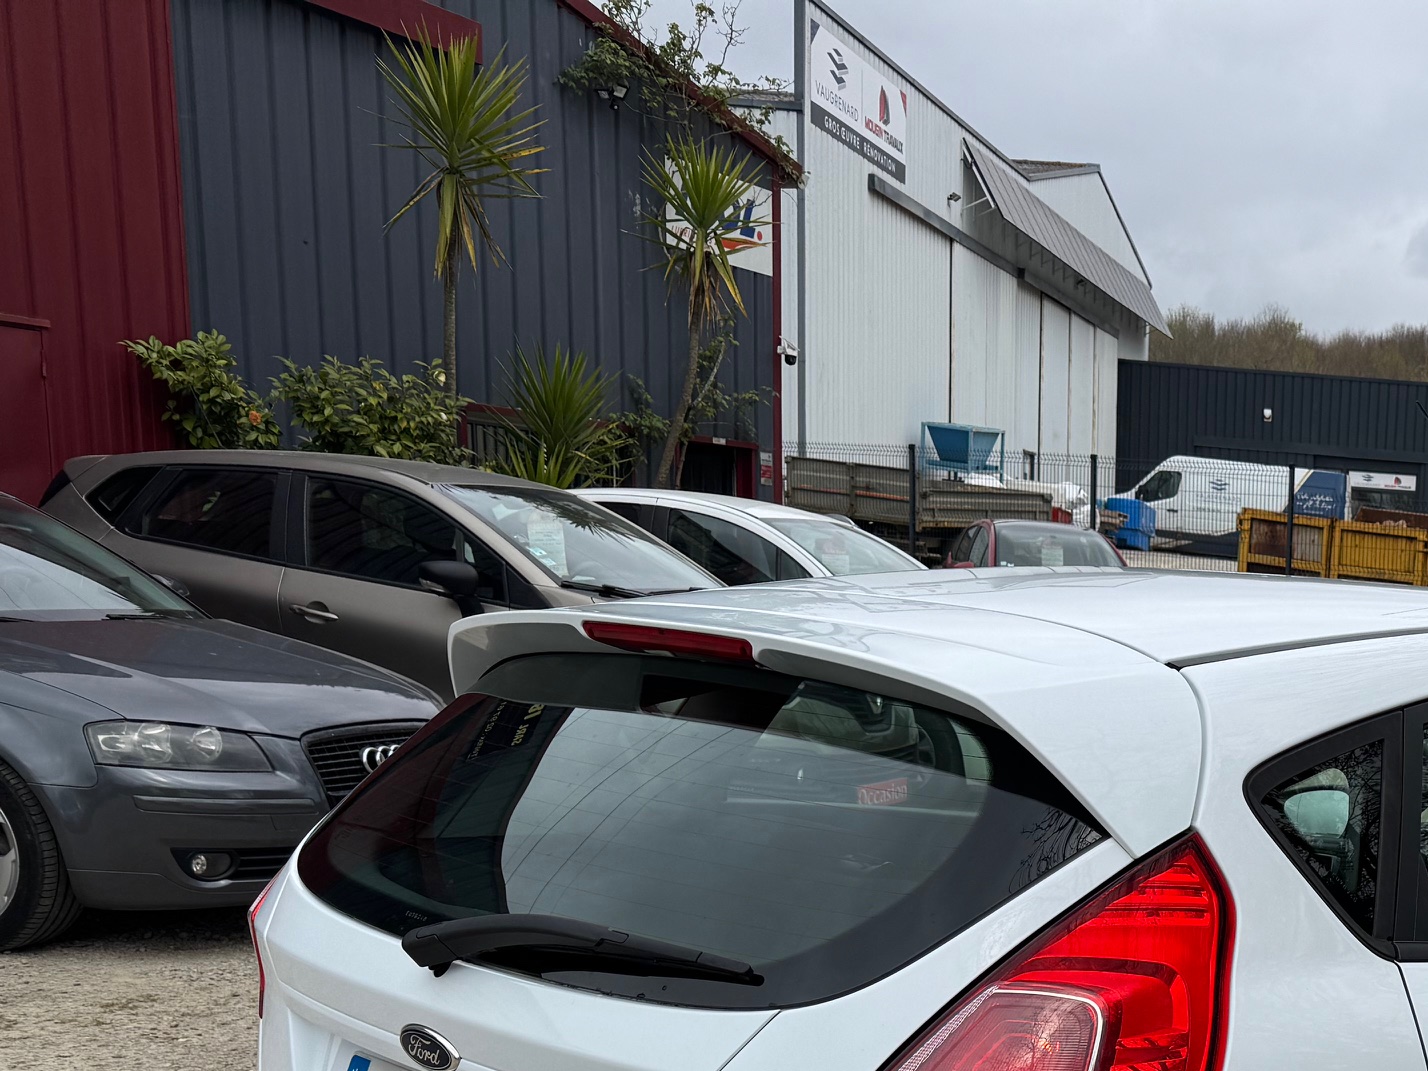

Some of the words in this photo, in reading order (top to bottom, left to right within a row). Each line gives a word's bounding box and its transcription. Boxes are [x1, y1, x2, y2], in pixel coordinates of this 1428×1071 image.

[815, 79, 859, 122] VAUGRENARD
[824, 115, 840, 136] GROS
[858, 784, 908, 806] Occasion
[408, 1034, 440, 1065] Ford
